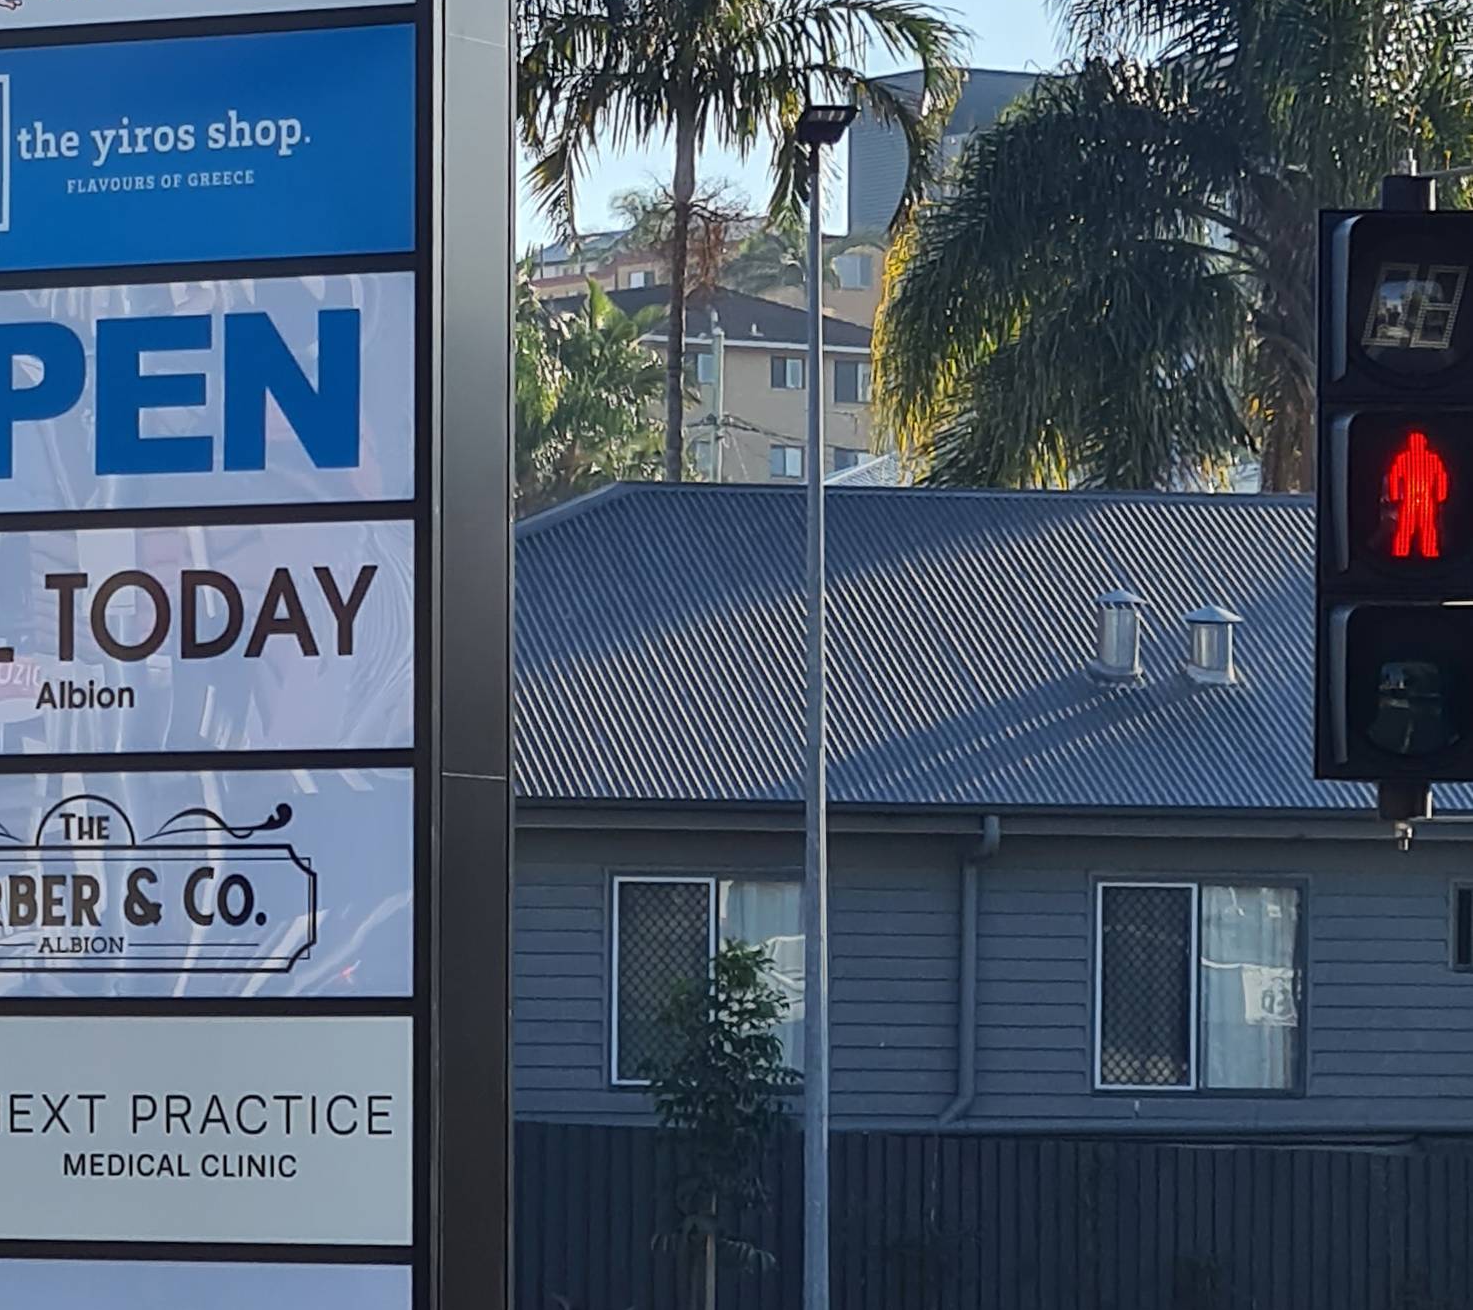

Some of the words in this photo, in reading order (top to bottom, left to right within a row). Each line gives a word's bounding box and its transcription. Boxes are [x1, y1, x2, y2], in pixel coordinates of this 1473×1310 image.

[16, 121, 80, 160] the
[90, 116, 196, 167] yiros
[207, 109, 311, 156] shop.
[67, 174, 155, 194] FLAVOURS
[160, 173, 183, 189] OF
[187, 169, 255, 187] GREECE
[44, 564, 379, 663] TODAY
[35, 679, 135, 710] Albion
[58, 812, 110, 841] THE
[123, 866, 163, 927] &
[183, 866, 267, 927] CO.
[38, 934, 125, 955] ALBION
[132, 1094, 393, 1136] PRACTICE
[63, 1153, 191, 1178] MEDICAL
[200, 1153, 297, 1178] CLINIC
